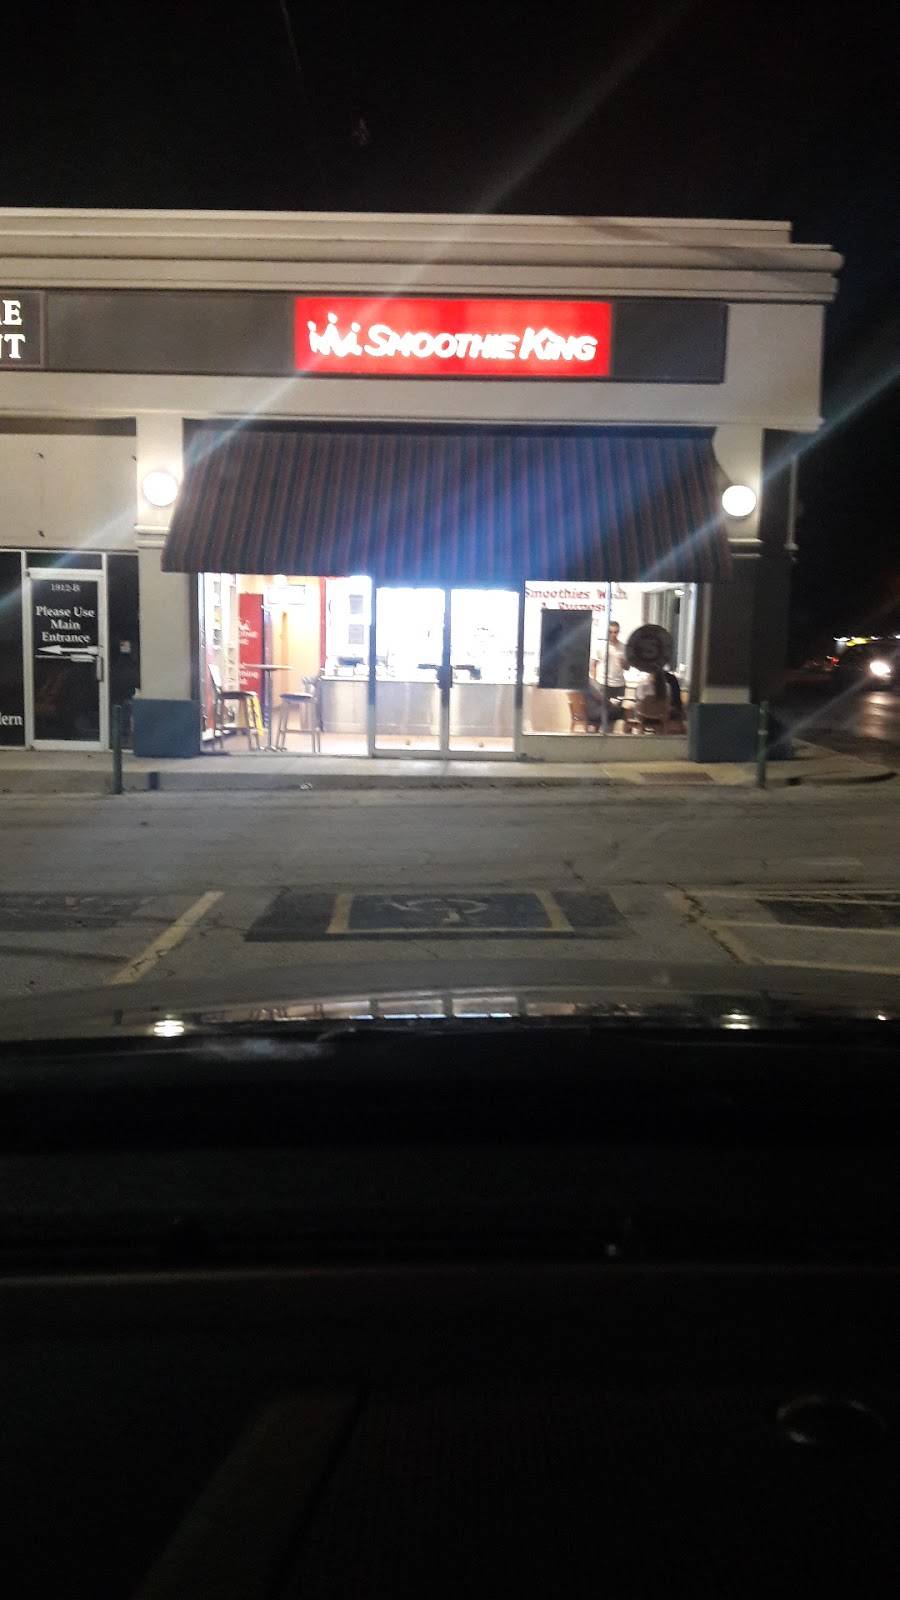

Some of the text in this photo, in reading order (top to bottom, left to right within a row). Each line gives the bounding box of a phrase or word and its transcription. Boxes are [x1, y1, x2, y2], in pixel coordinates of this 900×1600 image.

[0, 300, 22, 326] E
[525, 587, 590, 599] Smoothies
[36, 605, 96, 618] Please Use
[50, 619, 81, 630] Main
[41, 632, 91, 643] Entrance
